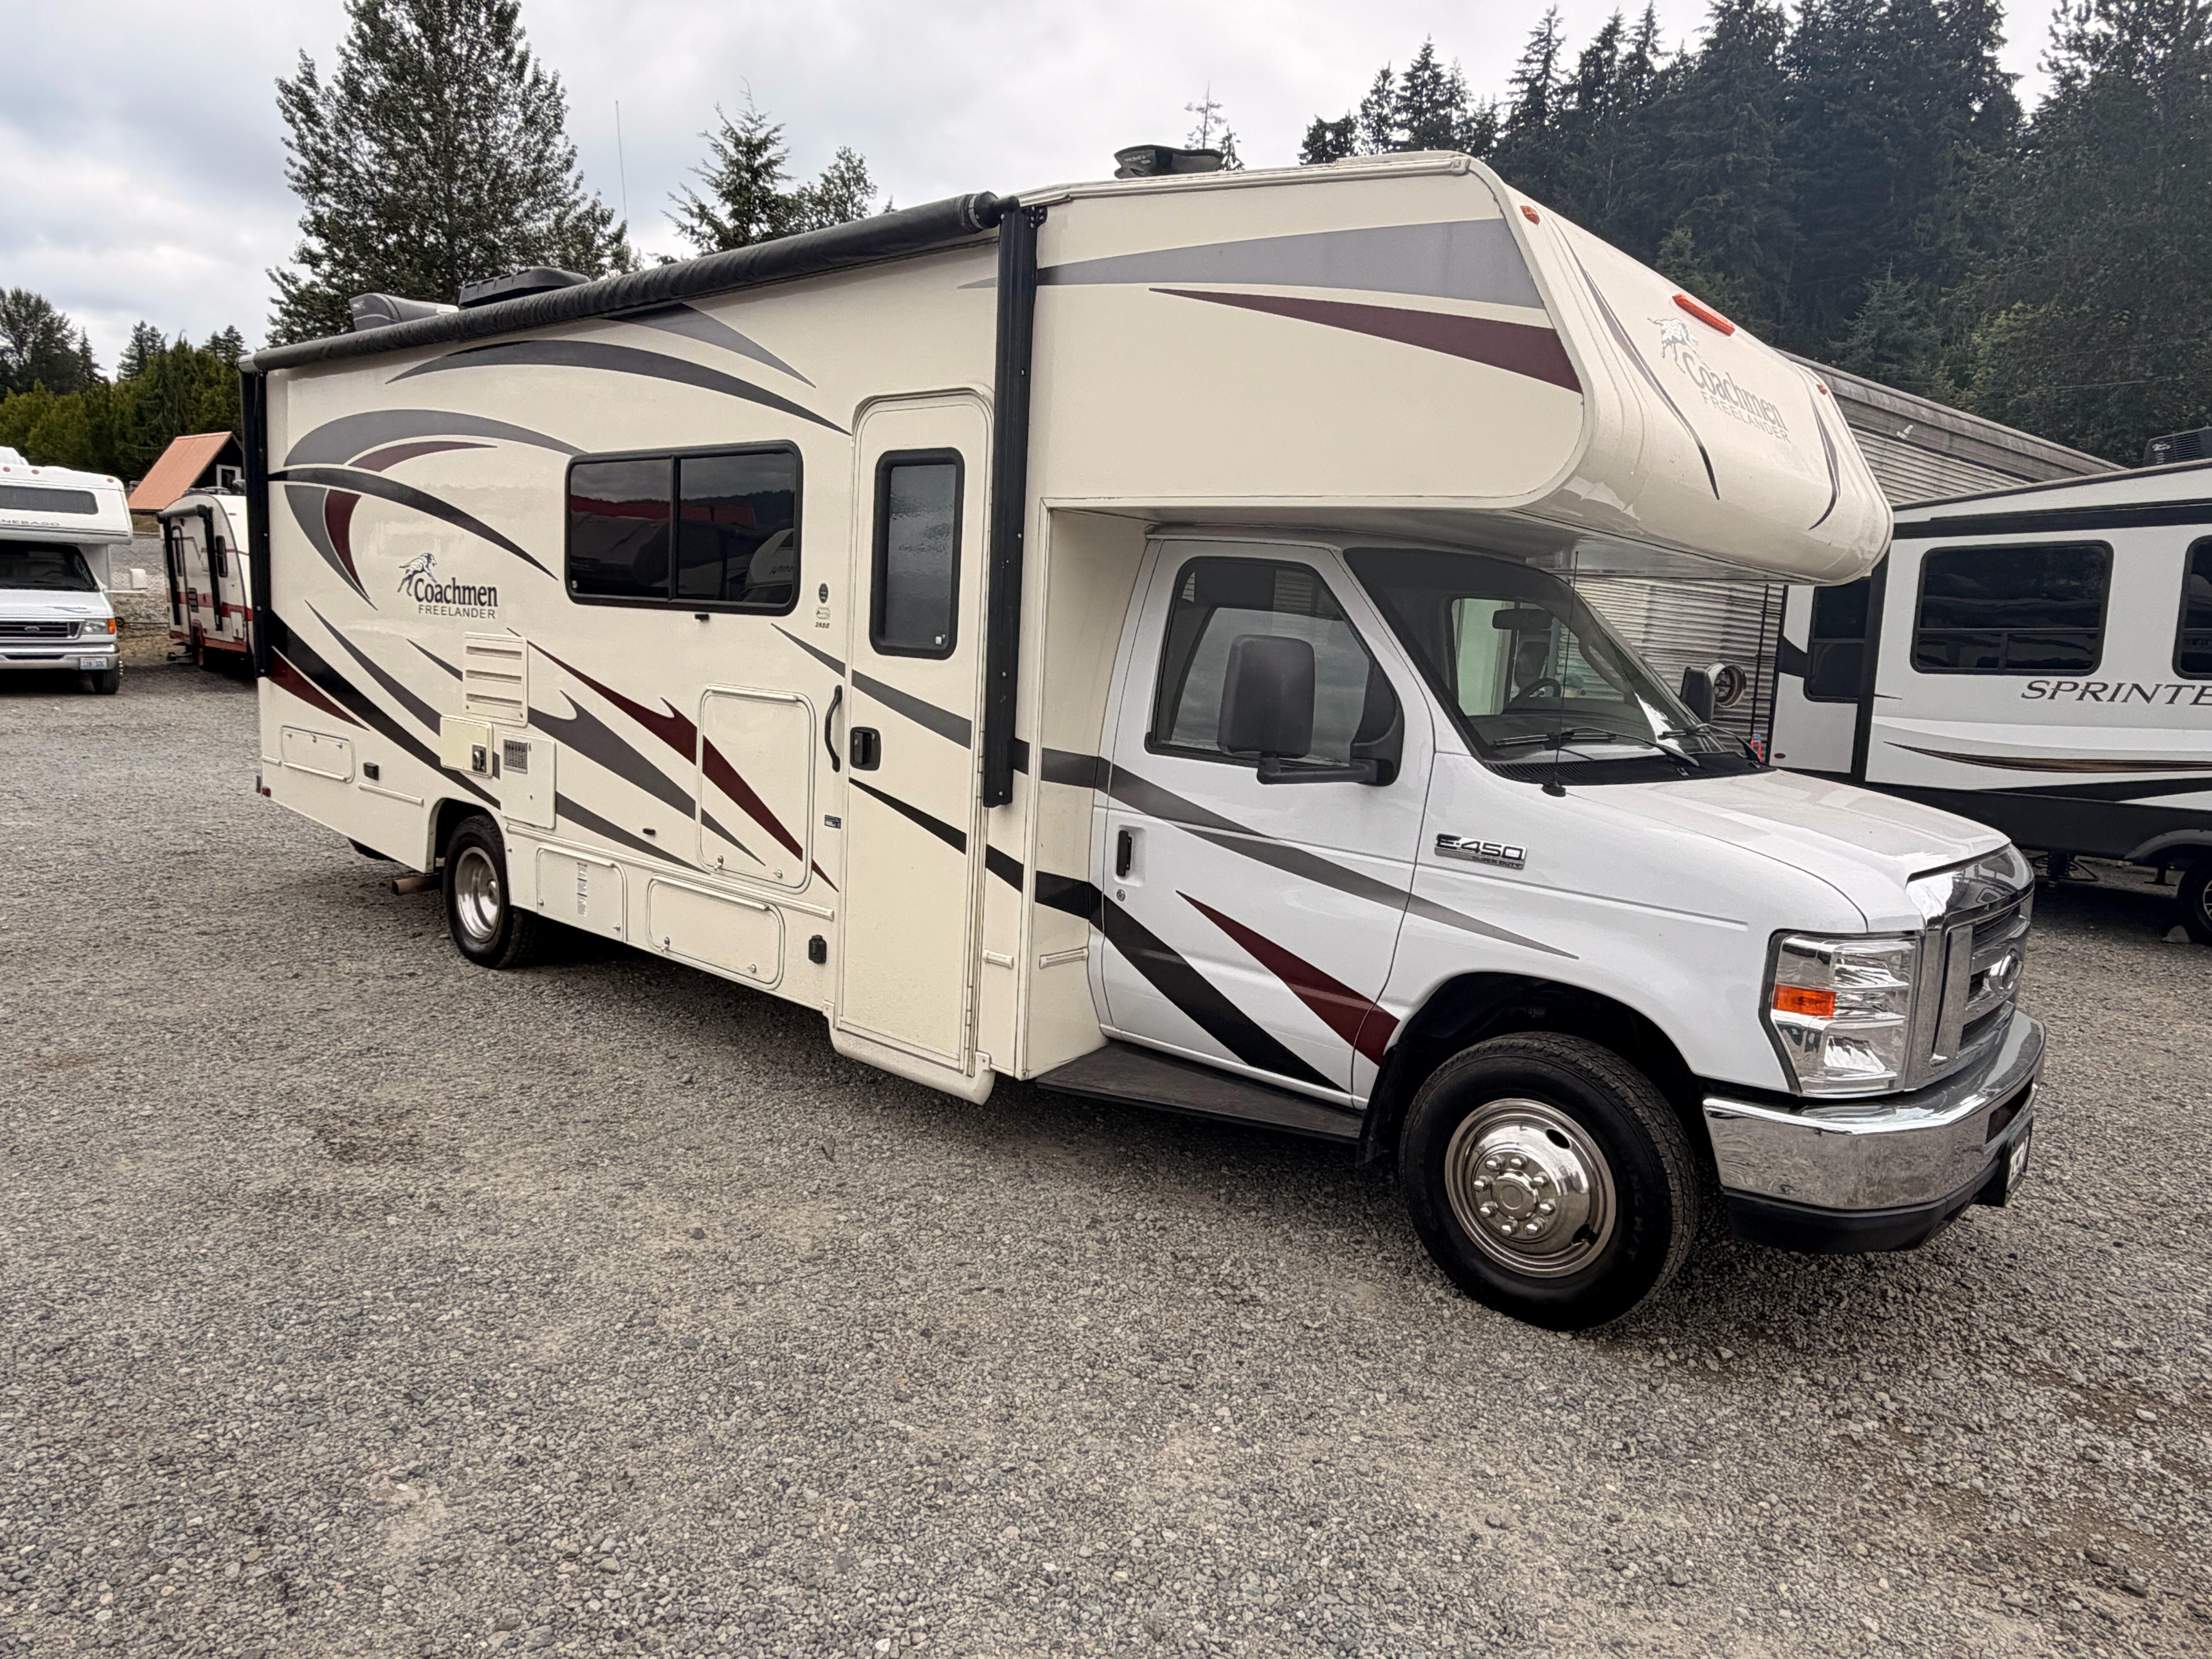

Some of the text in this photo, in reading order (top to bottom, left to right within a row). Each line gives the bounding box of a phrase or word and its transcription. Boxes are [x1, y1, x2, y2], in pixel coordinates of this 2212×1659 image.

[1683, 352, 1789, 431] Coachmen
[1700, 390, 1791, 443] FREELANDER
[414, 577, 498, 607] Coachmen
[418, 604, 496, 619] FREELANDER
[2021, 680, 2212, 706] SPRINTE
[1436, 833, 1524, 860] E-450
